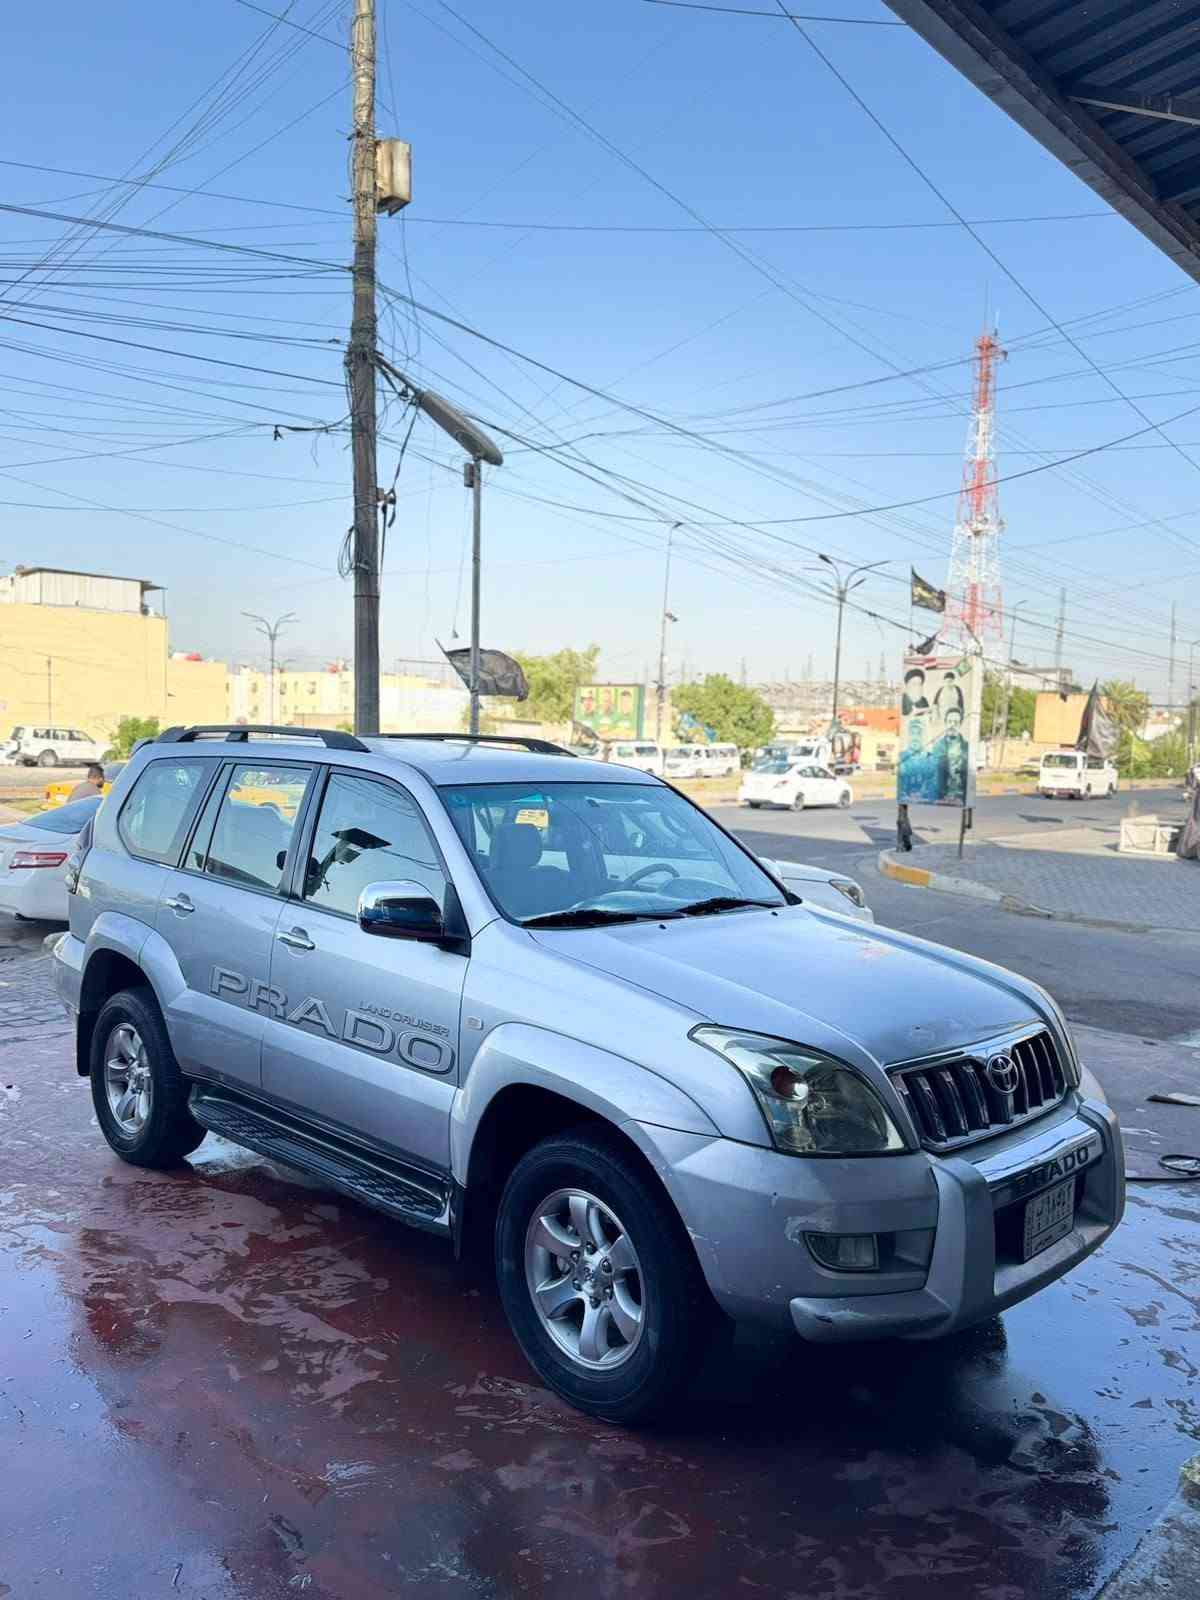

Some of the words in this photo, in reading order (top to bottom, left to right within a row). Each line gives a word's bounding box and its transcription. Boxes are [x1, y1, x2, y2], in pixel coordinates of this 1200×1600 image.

[209, 965, 456, 1075] PRADO
[359, 1000, 391, 1018] LAND
[392, 1012, 450, 1037] CRUISER
